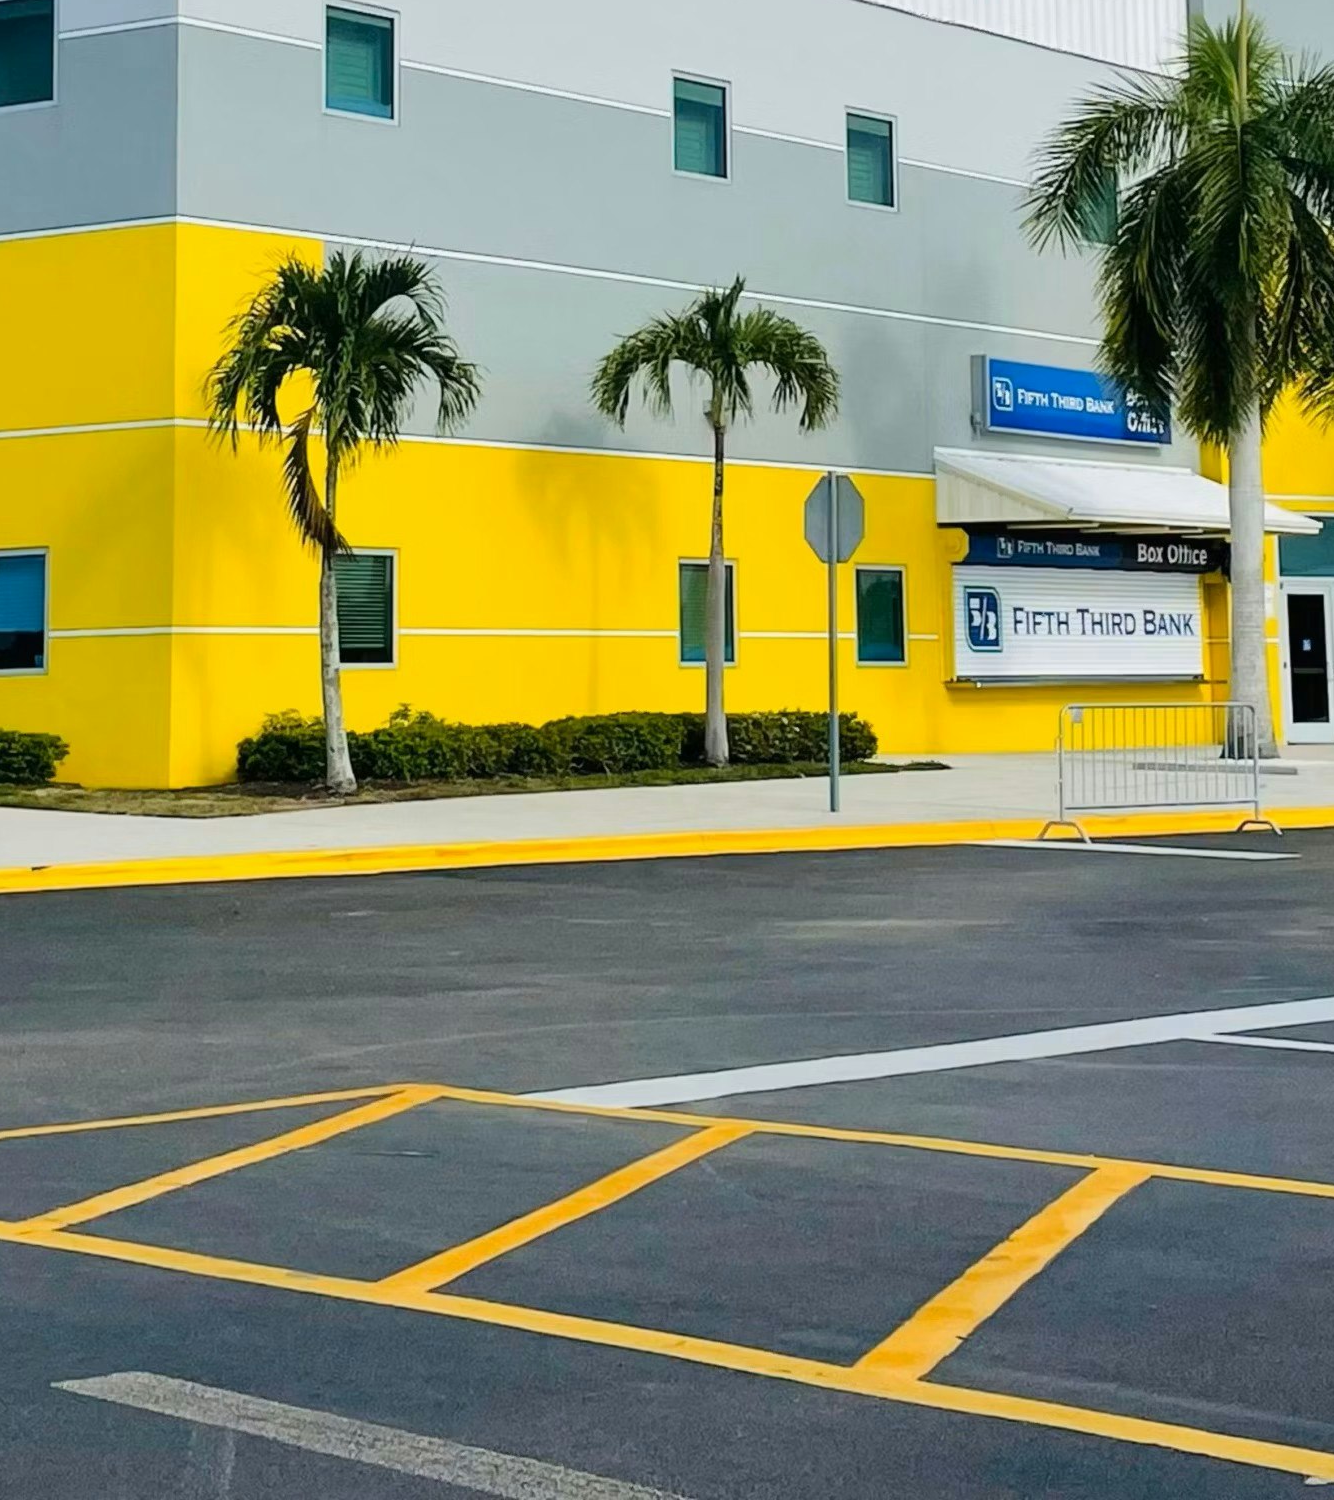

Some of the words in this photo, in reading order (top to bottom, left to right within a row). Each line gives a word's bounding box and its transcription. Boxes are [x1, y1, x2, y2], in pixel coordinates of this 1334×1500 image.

[1017, 388, 1049, 407] FIFTH
[1050, 392, 1084, 412] THIRD
[1085, 396, 1115, 414] BANK
[1018, 540, 1044, 554] FIFTH
[1045, 541, 1074, 556] THIRD
[1075, 543, 1100, 557] BANK
[1137, 543, 1164, 563] Box
[1167, 544, 1207, 565] Office
[1013, 607, 1070, 635] FIFTH
[1076, 608, 1136, 635] THIRD
[1142, 609, 1195, 636] BANK
